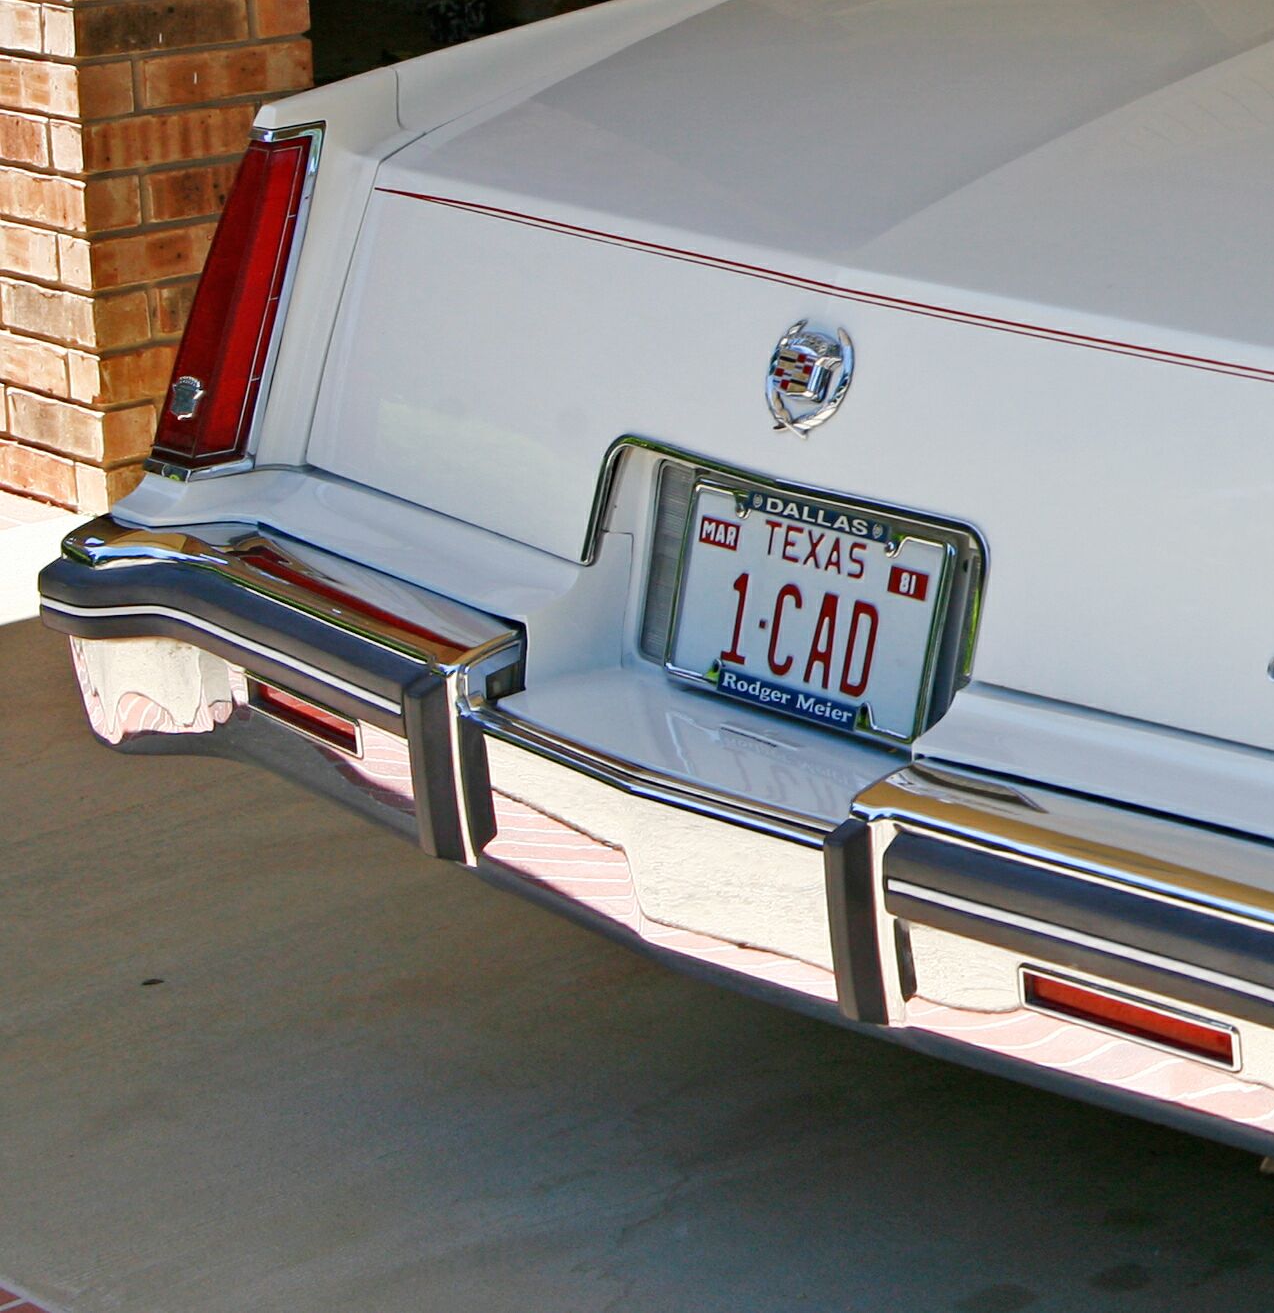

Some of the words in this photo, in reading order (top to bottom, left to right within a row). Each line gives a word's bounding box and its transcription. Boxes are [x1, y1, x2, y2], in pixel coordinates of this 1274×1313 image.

[702, 521, 737, 547] MAR
[766, 498, 869, 536] DALLAS
[765, 519, 867, 579] TEXAS
[899, 572, 917, 595] 81
[722, 671, 791, 705] Rodger
[795, 693, 853, 723] Meier
